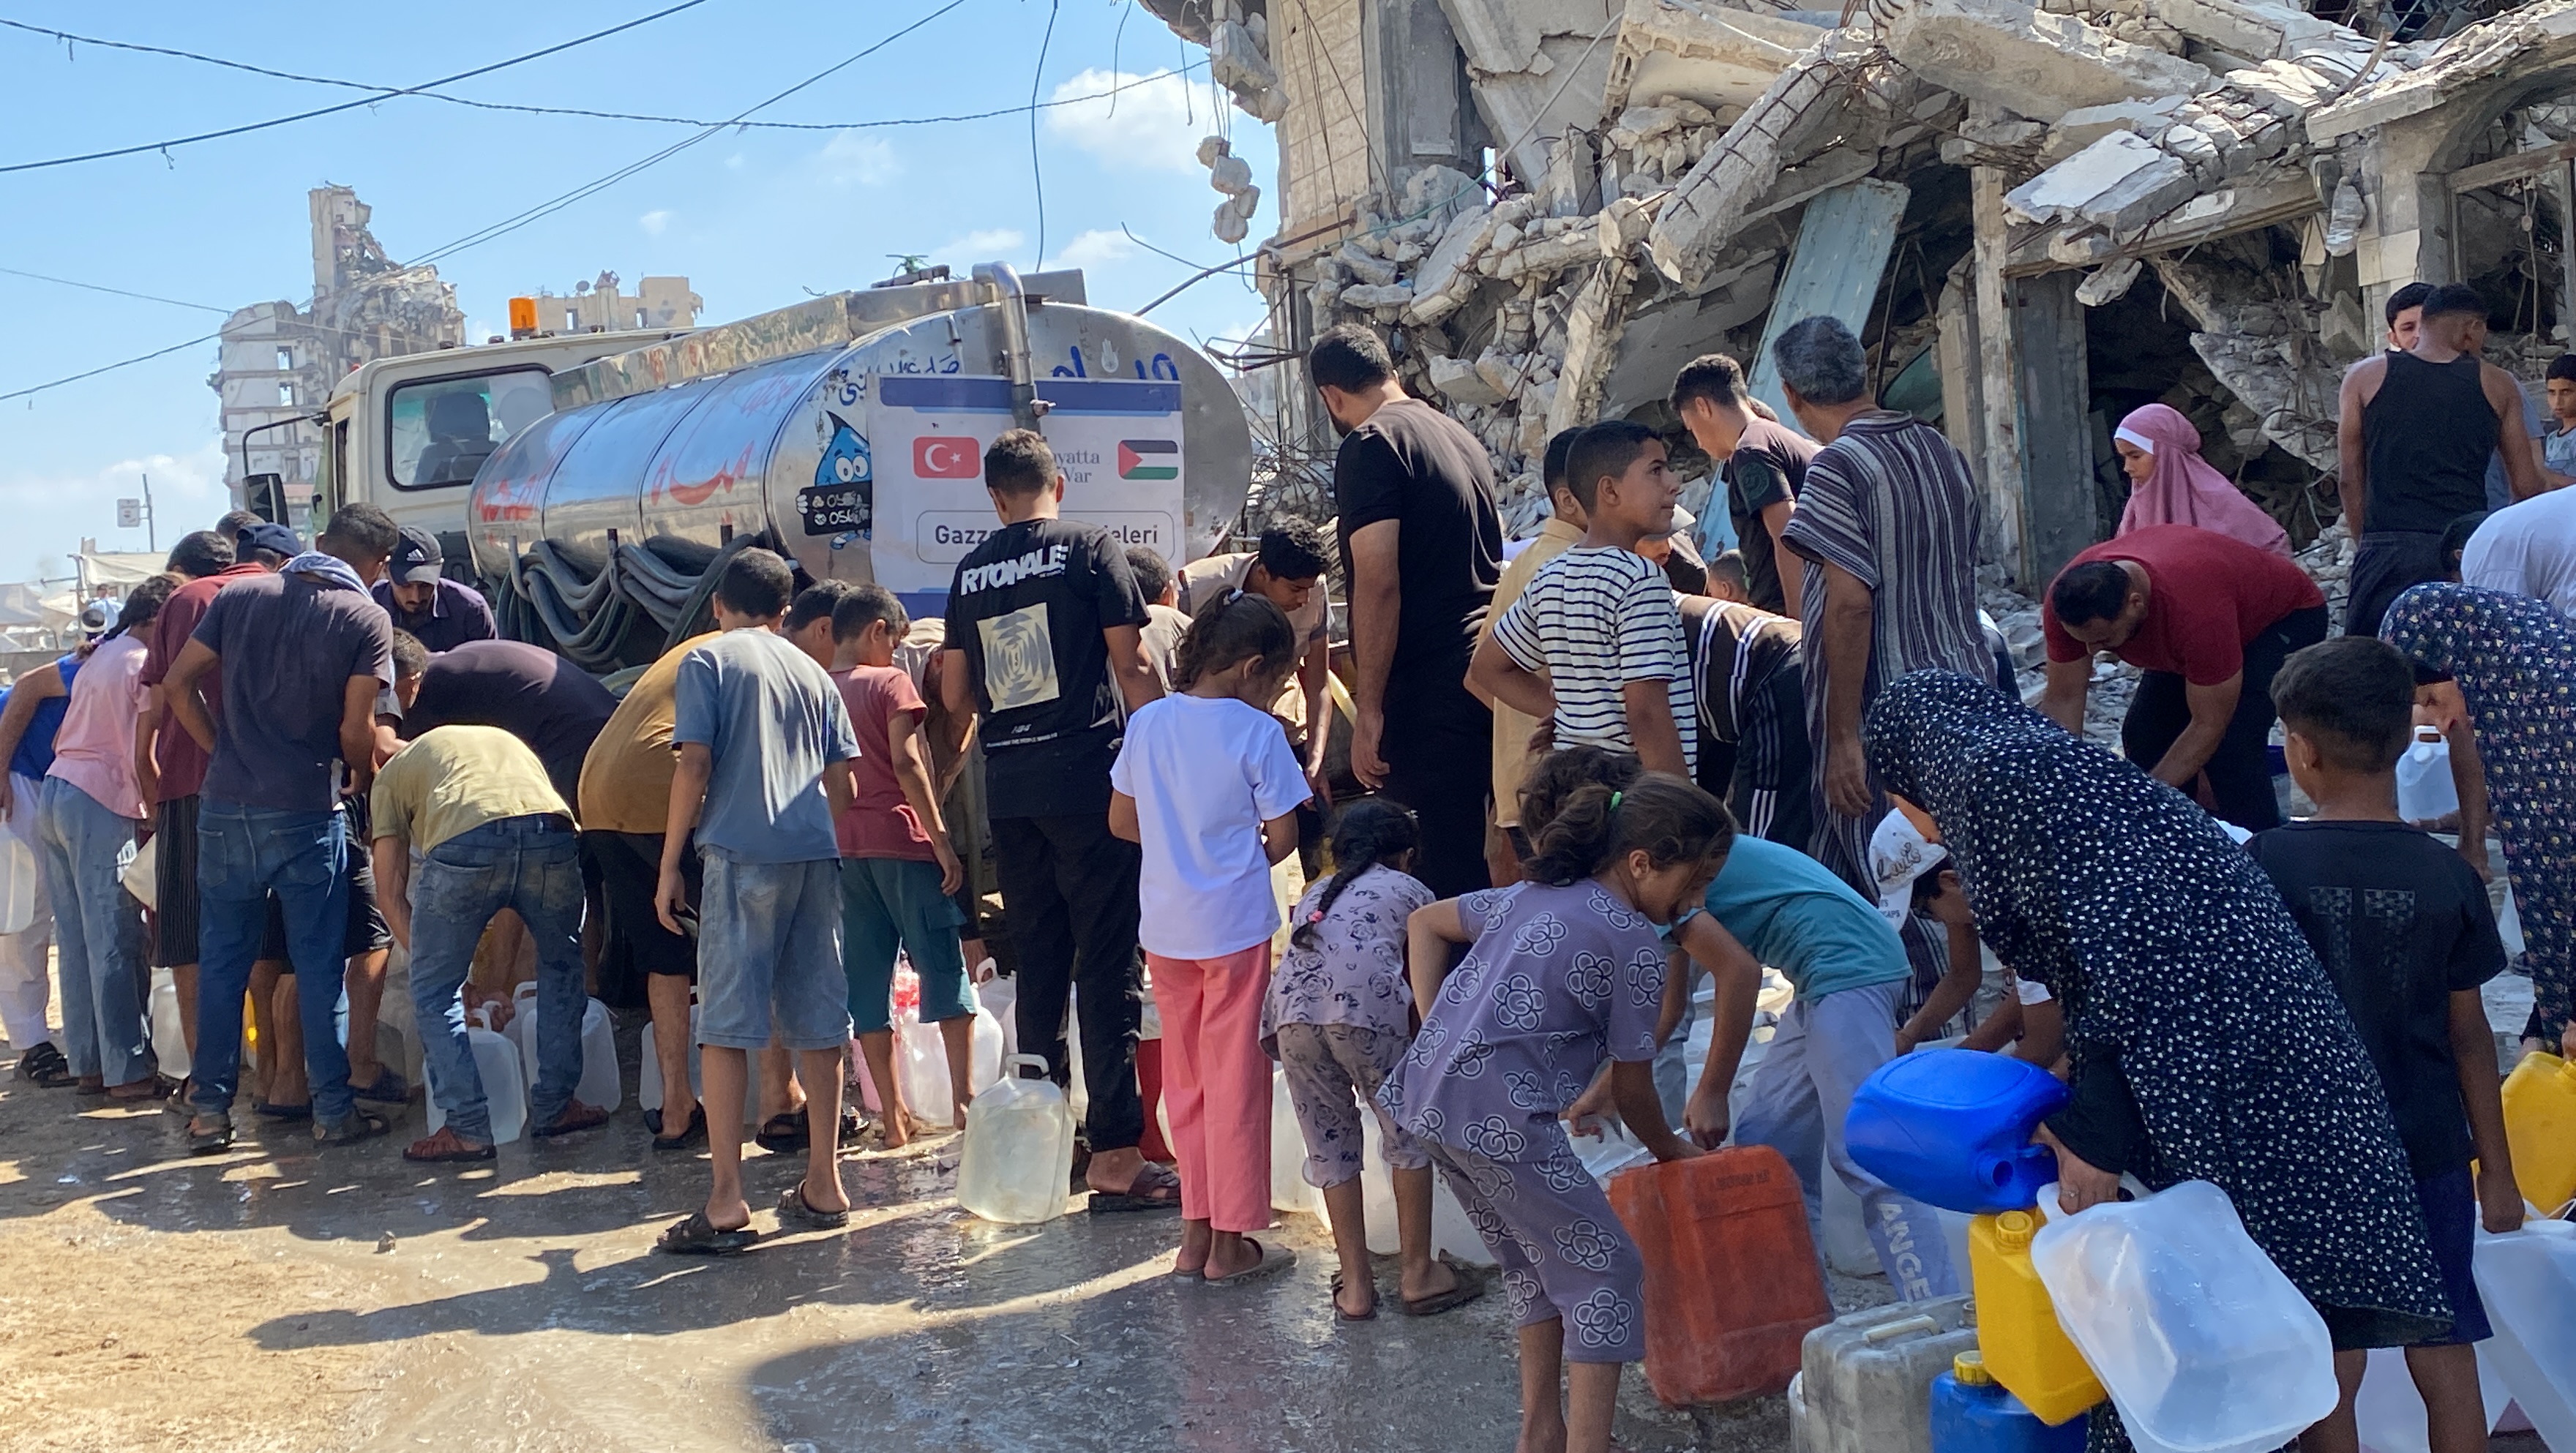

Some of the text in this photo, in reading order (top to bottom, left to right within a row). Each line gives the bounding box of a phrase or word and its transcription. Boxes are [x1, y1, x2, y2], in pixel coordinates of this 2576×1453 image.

[1062, 466, 1093, 484] Var
[935, 525, 1158, 544] Gazz eleri
